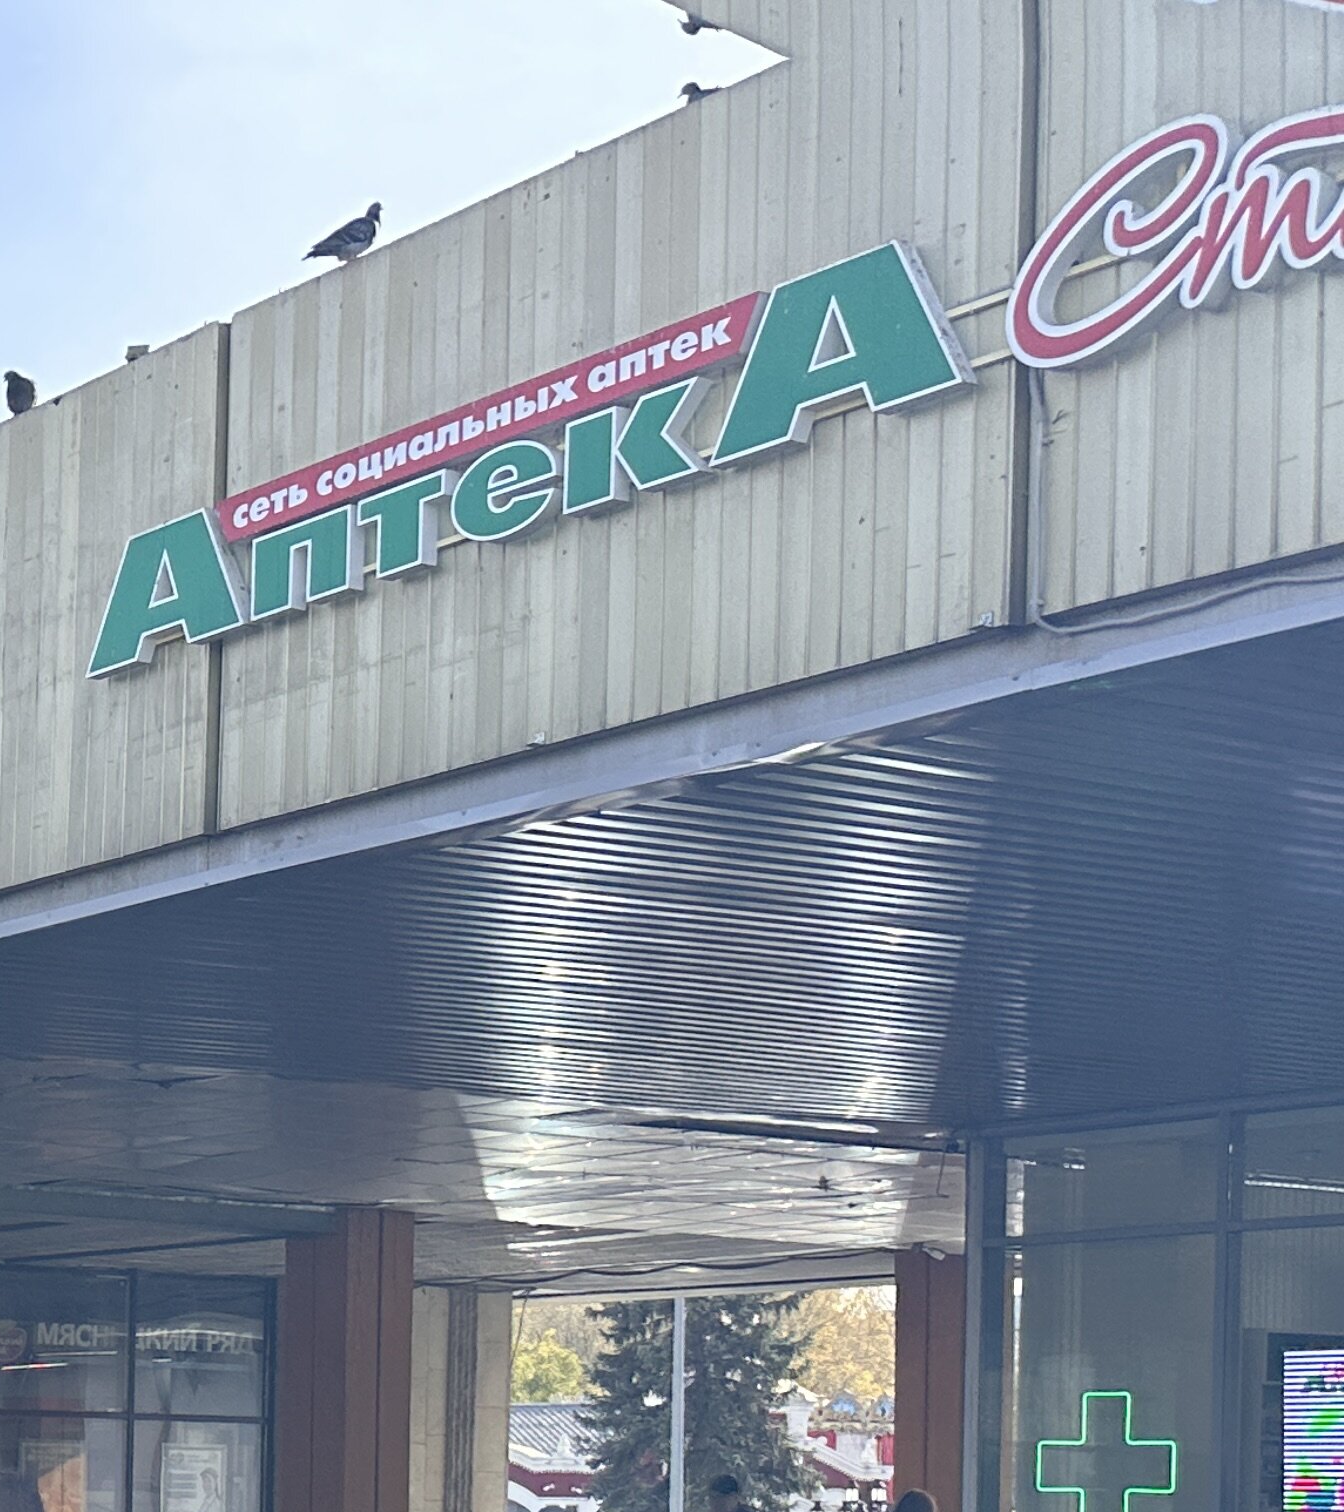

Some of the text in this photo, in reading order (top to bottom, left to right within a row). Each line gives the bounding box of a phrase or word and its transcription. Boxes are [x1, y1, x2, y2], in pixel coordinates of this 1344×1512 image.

[232, 311, 732, 532] сеть социальных аптек
